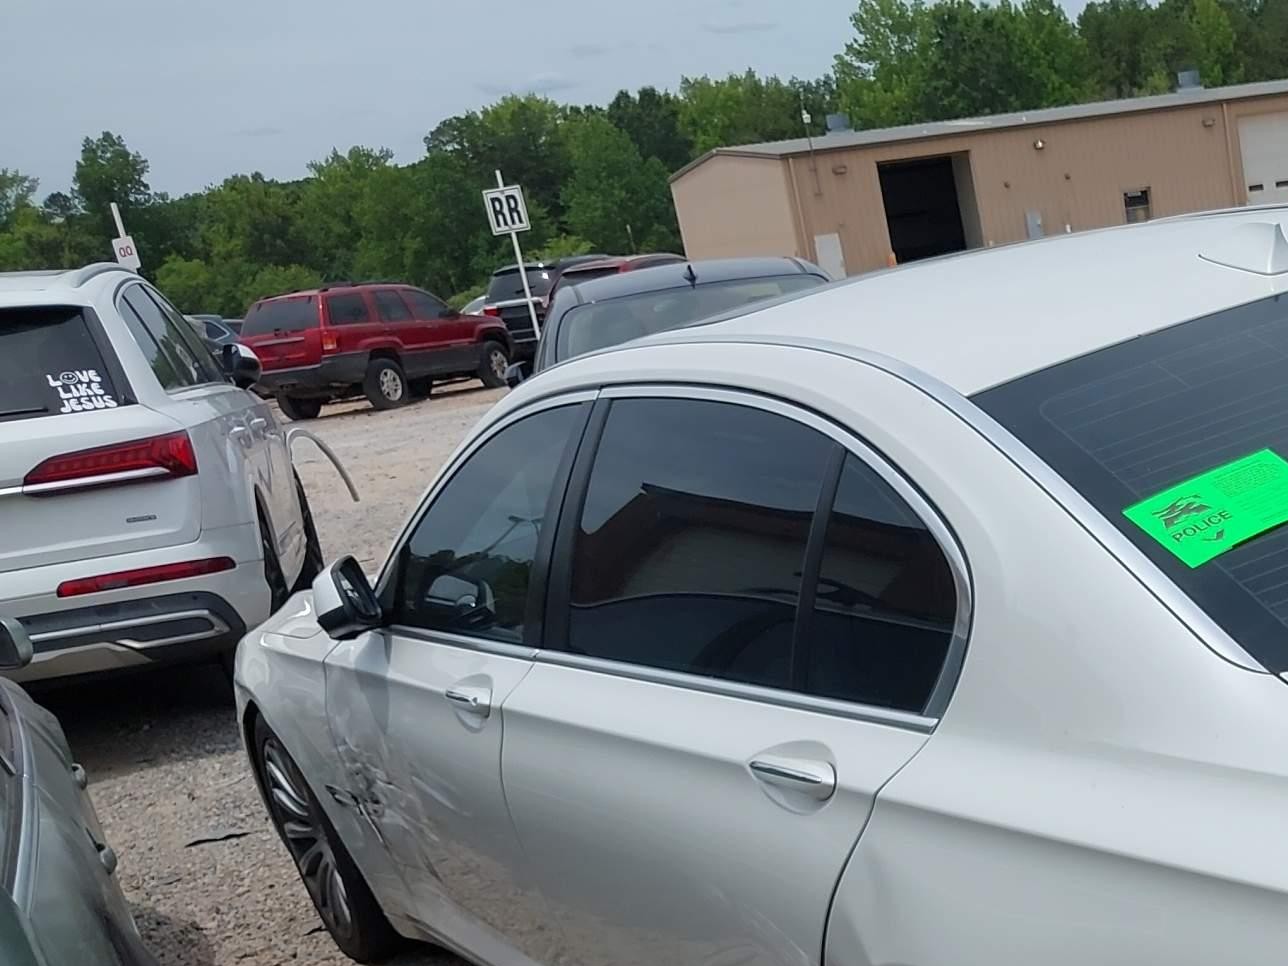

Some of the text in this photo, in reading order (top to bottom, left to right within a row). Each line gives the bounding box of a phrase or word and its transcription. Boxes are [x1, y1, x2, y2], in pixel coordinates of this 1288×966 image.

[490, 194, 525, 228] RR
[118, 245, 134, 258] QQ
[57, 383, 105, 399] LIKE
[60, 395, 118, 413] JESUS
[1171, 510, 1233, 542] POLICE
